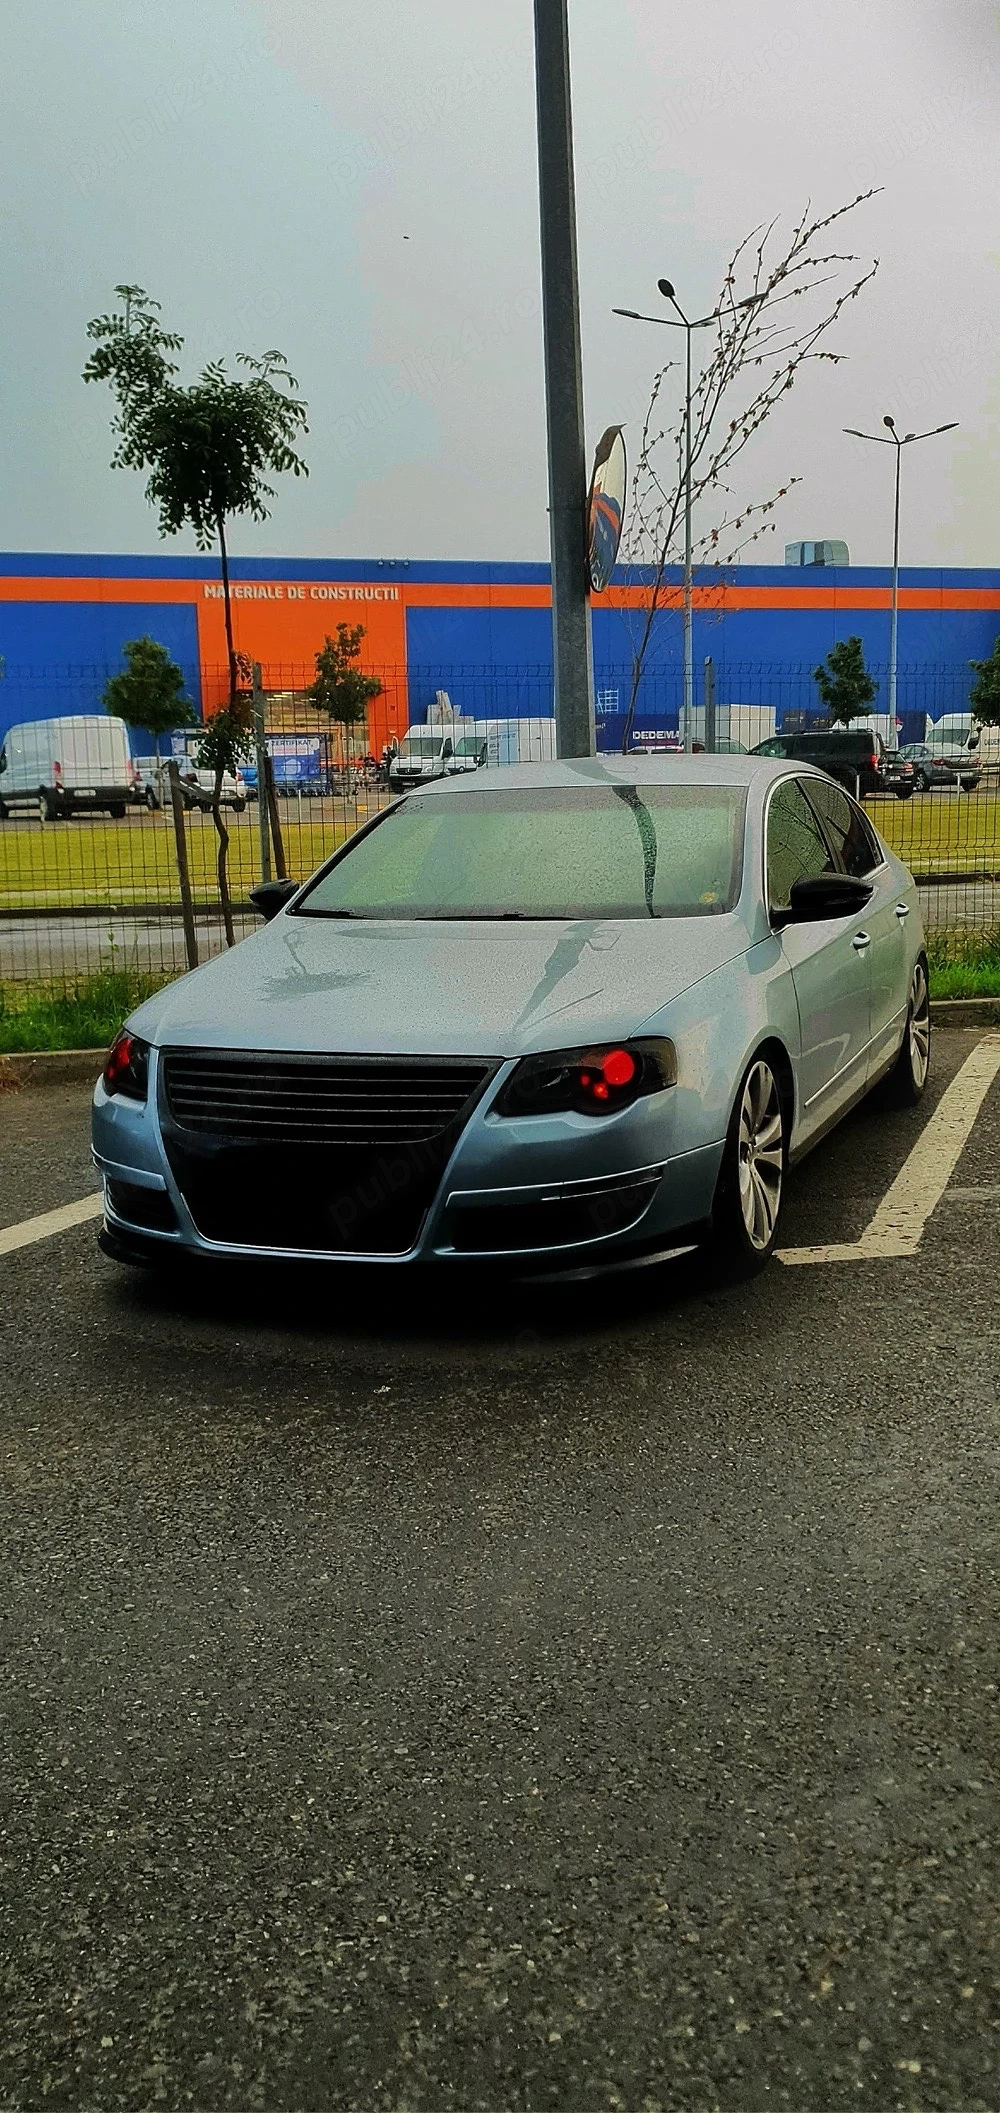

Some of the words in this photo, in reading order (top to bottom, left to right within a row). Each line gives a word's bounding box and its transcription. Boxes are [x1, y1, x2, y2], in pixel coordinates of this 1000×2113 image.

[203, 584, 284, 599] MATERIALE
[287, 586, 306, 599] DE
[310, 587, 399, 600] CONSTRUCTII
